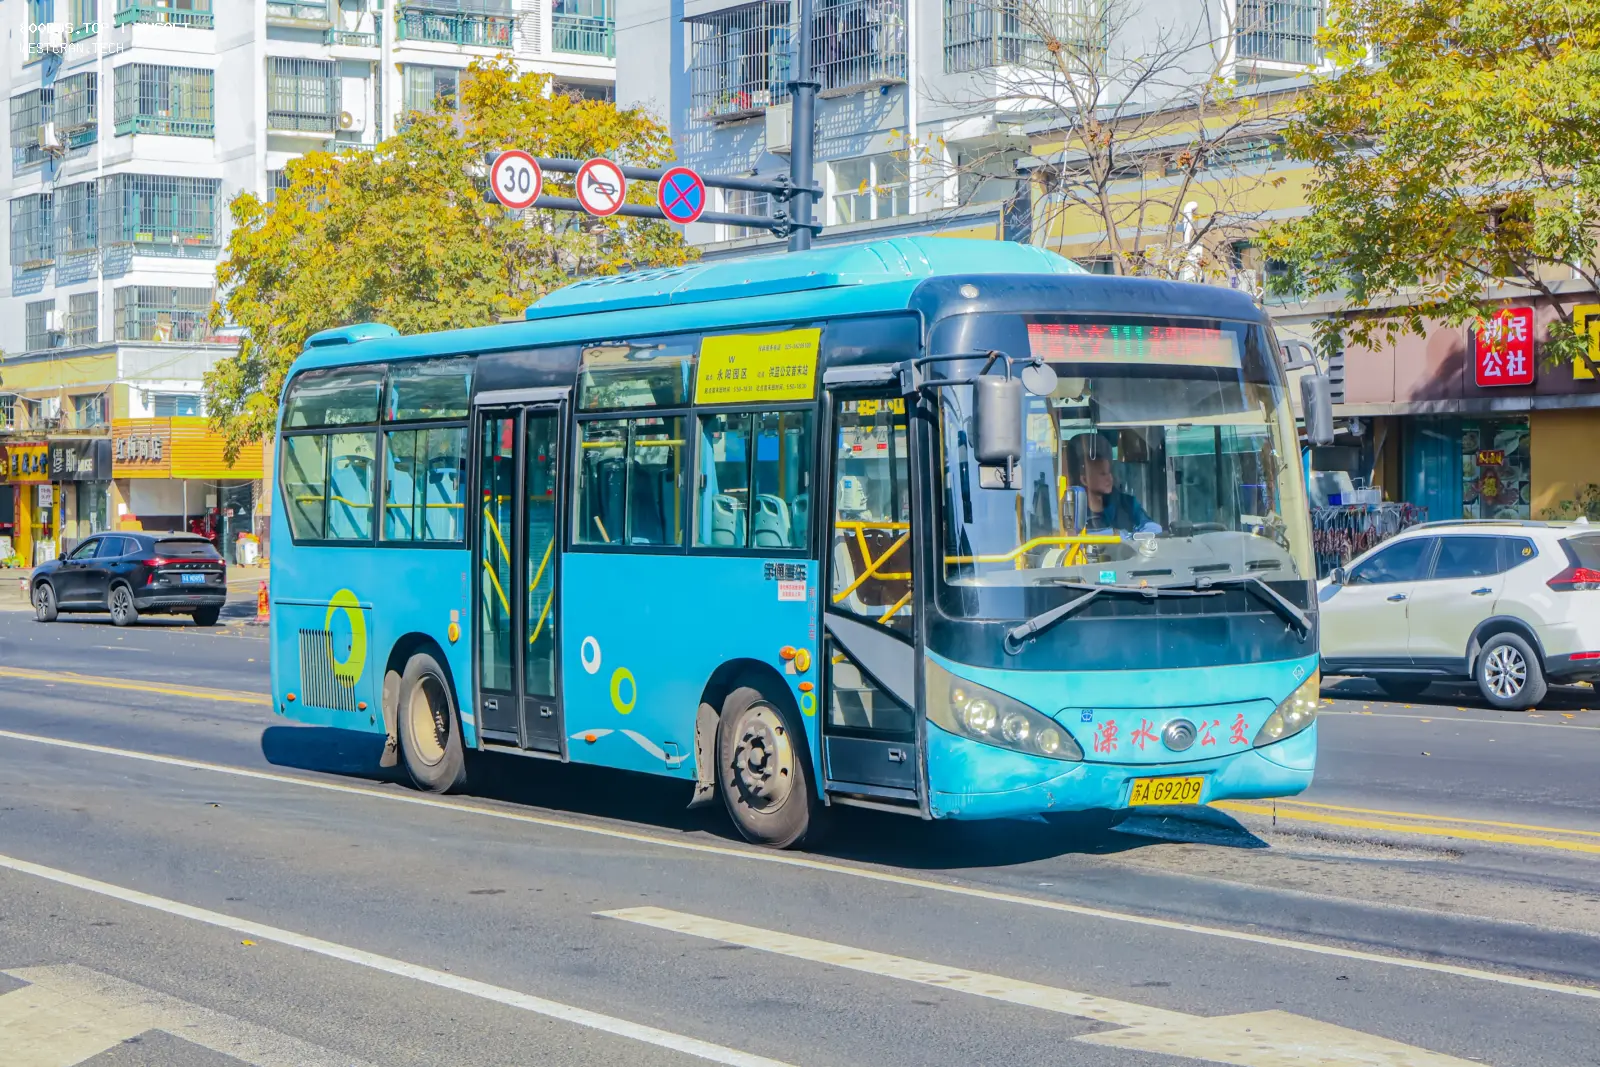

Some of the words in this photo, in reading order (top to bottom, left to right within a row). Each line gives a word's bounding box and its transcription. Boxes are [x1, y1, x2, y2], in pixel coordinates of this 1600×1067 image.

[504, 166, 530, 194] 30
[1111, 325, 1144, 361] 111
[717, 367, 748, 380] 永阳园区
[1482, 350, 1527, 377] 公社
